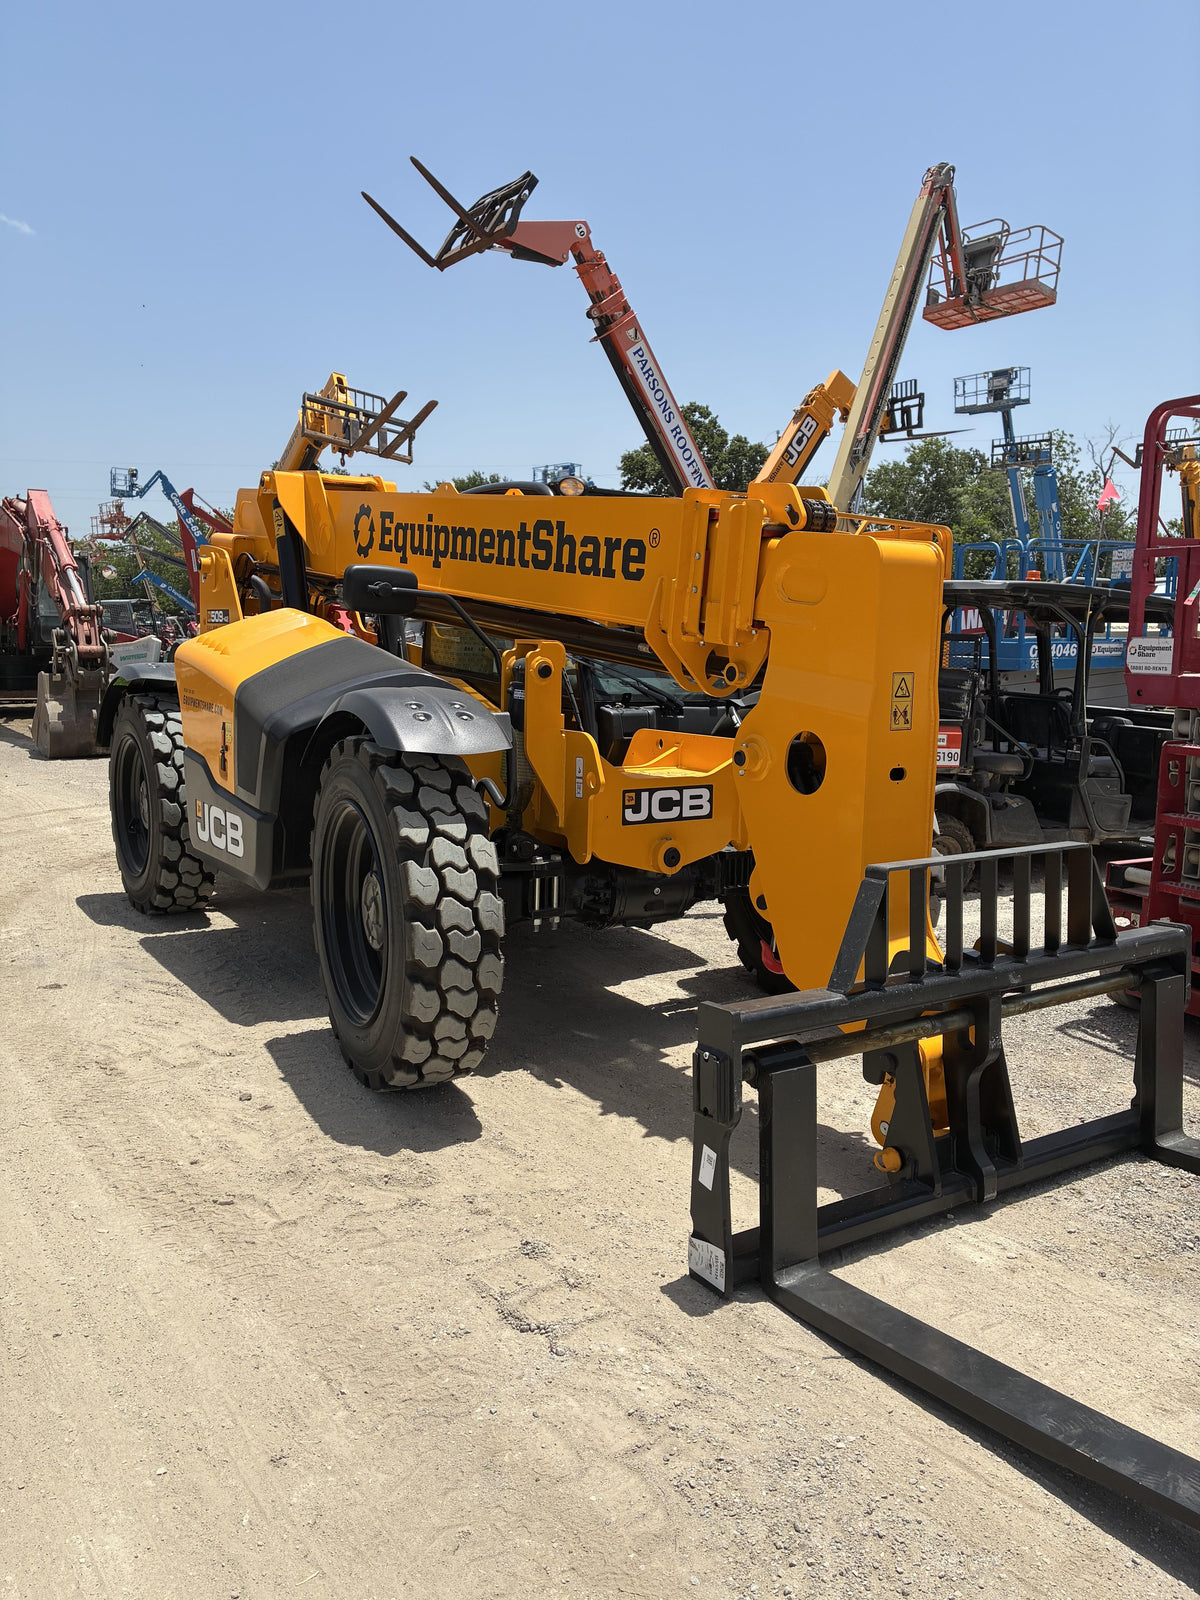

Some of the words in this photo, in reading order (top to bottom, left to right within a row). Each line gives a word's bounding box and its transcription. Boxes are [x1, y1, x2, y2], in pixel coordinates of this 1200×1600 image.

[633, 346, 675, 424] PARSONS
[786, 416, 818, 465] JCB
[170, 492, 187, 515] Genie
[185, 517, 203, 537] S-65
[624, 787, 711, 822] JCB
[196, 803, 244, 858] JCB
